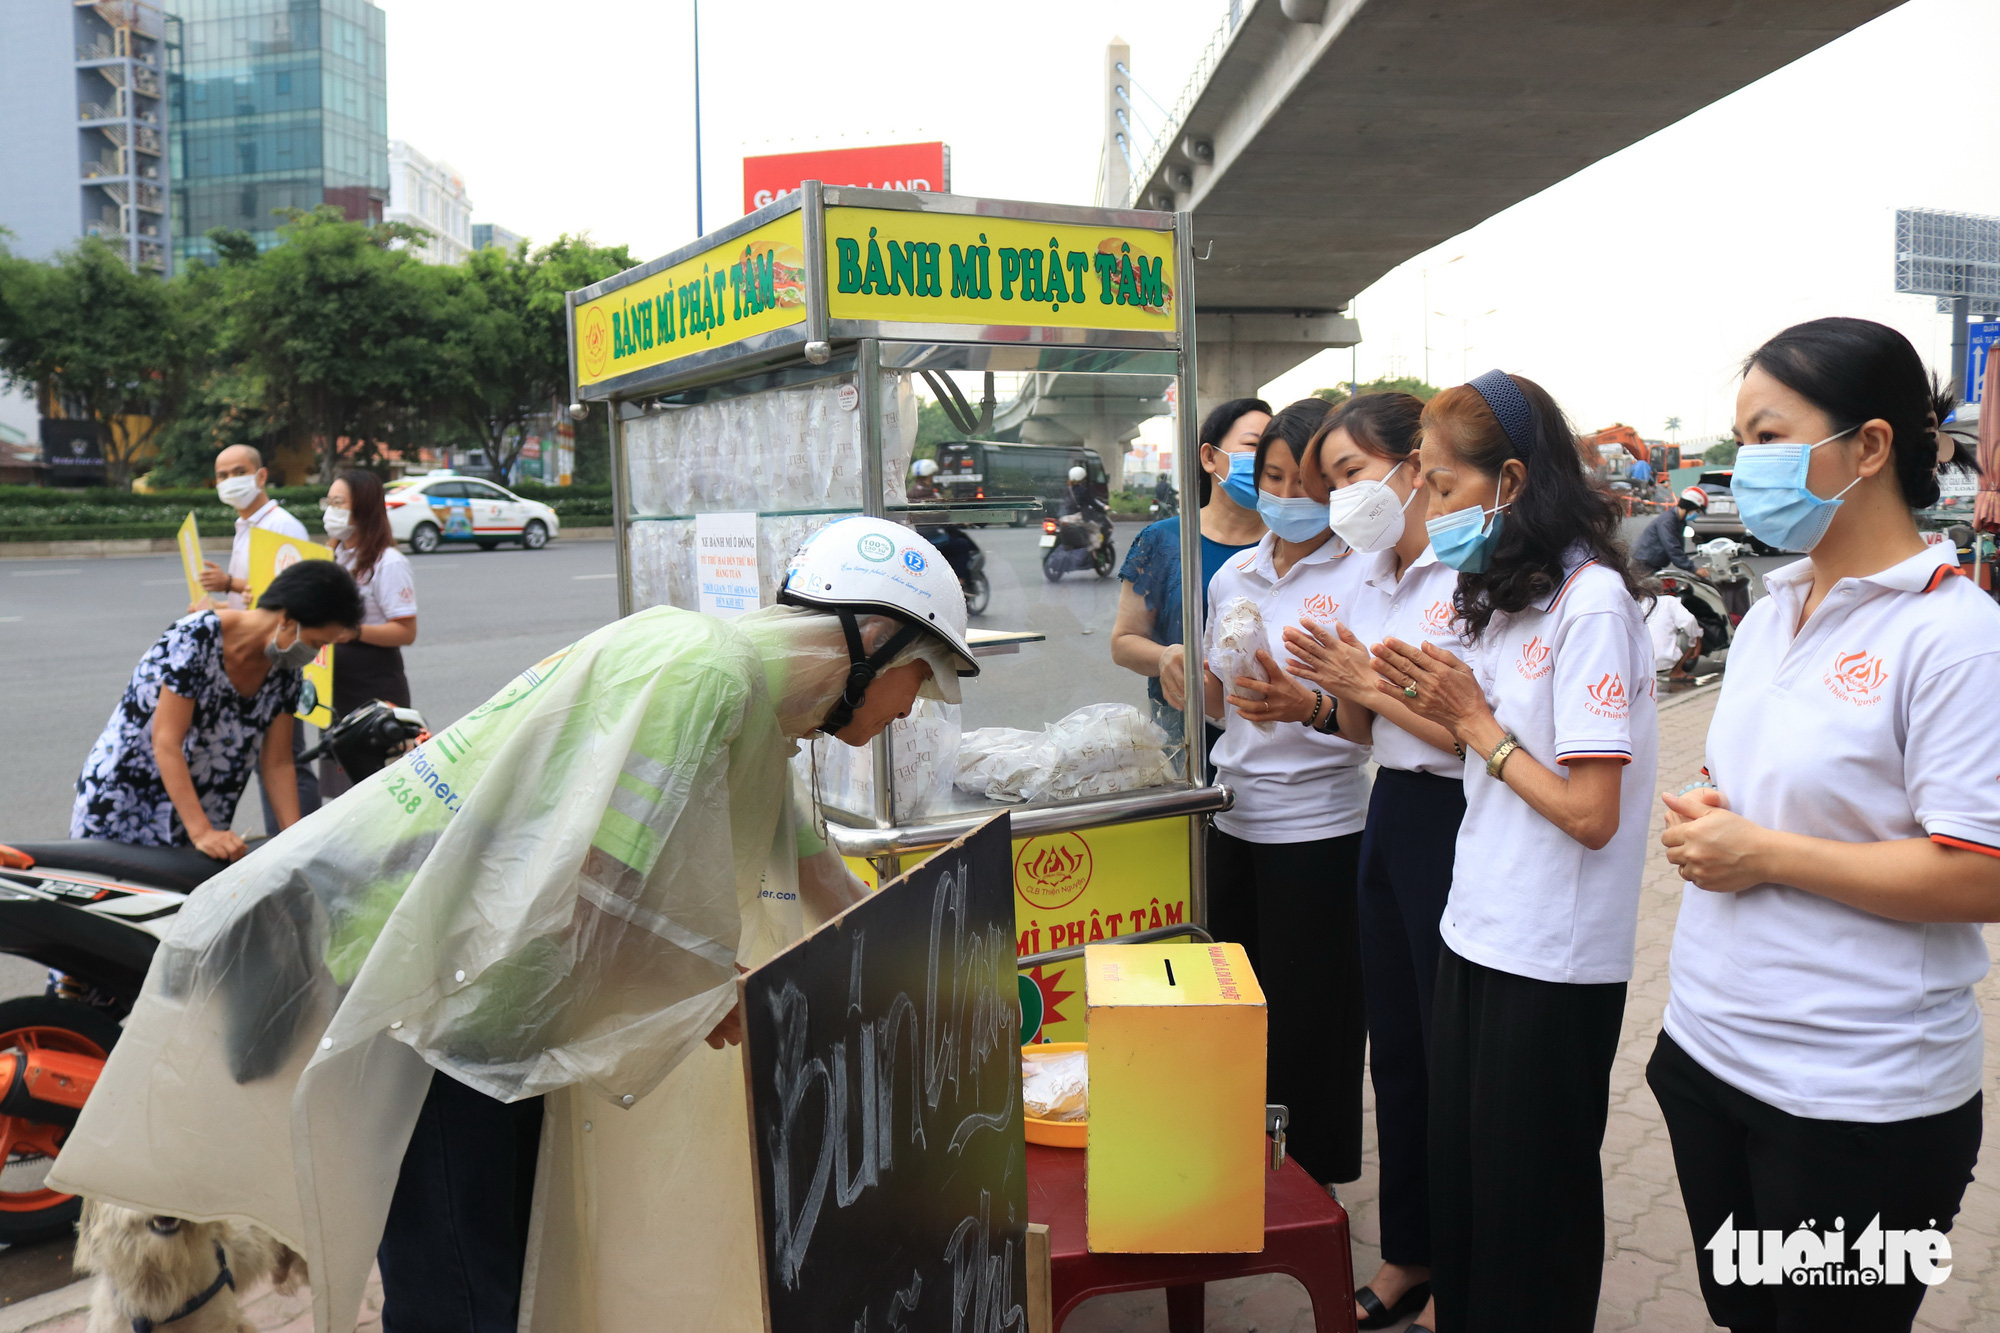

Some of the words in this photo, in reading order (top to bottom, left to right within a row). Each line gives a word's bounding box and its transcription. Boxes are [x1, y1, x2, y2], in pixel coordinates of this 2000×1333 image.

[836, 226, 942, 298] BÁNH
[949, 232, 992, 300] MÌ
[999, 236, 1089, 313] PHẬT
[1092, 241, 1165, 307] TÂM
[612, 297, 653, 360] BÁNH
[656, 278, 676, 346] MÌ
[678, 262, 726, 341] PHẬT
[730, 243, 775, 321] TÂM
[864, 540, 890, 550] 100%
[907, 555, 922, 568] 12
[1584, 702, 1601, 715] CLB
[409, 746, 462, 813] tainer.
[1025, 885, 1040, 895] CLB
[1042, 887, 1060, 896] Thiện
[1061, 877, 1086, 893] Nguyện
[1130, 897, 1184, 933] TÂM
